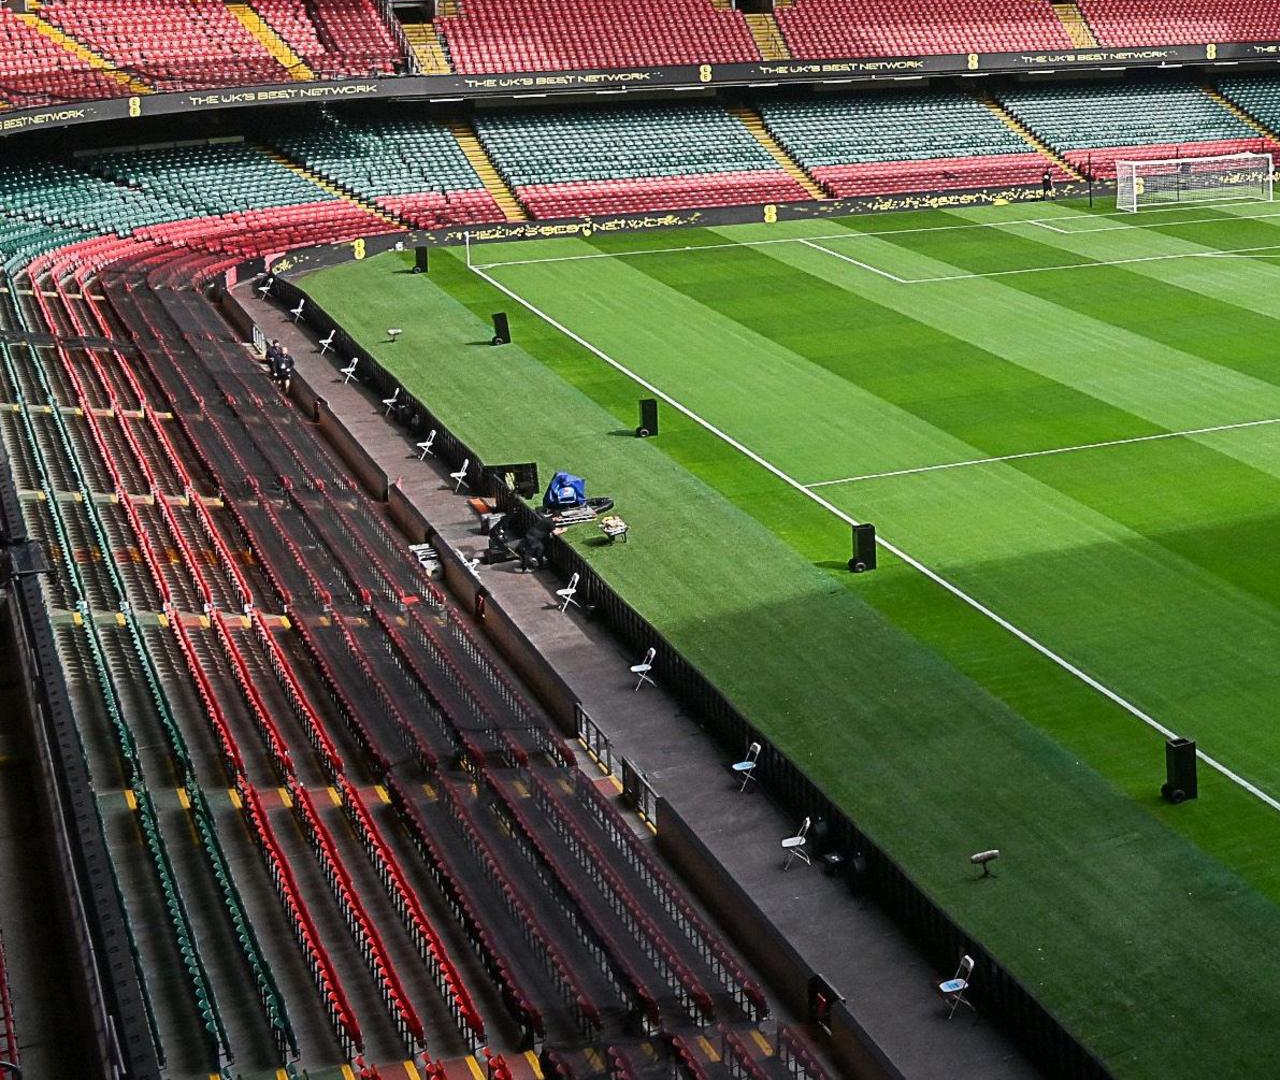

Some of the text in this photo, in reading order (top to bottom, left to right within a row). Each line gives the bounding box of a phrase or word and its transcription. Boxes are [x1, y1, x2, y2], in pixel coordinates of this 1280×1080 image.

[760, 66, 788, 74] THE
[823, 62, 858, 72] BEST
[860, 60, 923, 71] NETWORK
[466, 79, 496, 88] THE
[536, 75, 575, 85] BEST
[578, 72, 650, 83] NETWORK
[190, 95, 219, 106] THE
[257, 89, 296, 99] BEST
[300, 85, 376, 96] NETWORK
[3, 110, 83, 129] BEST NETWORK
